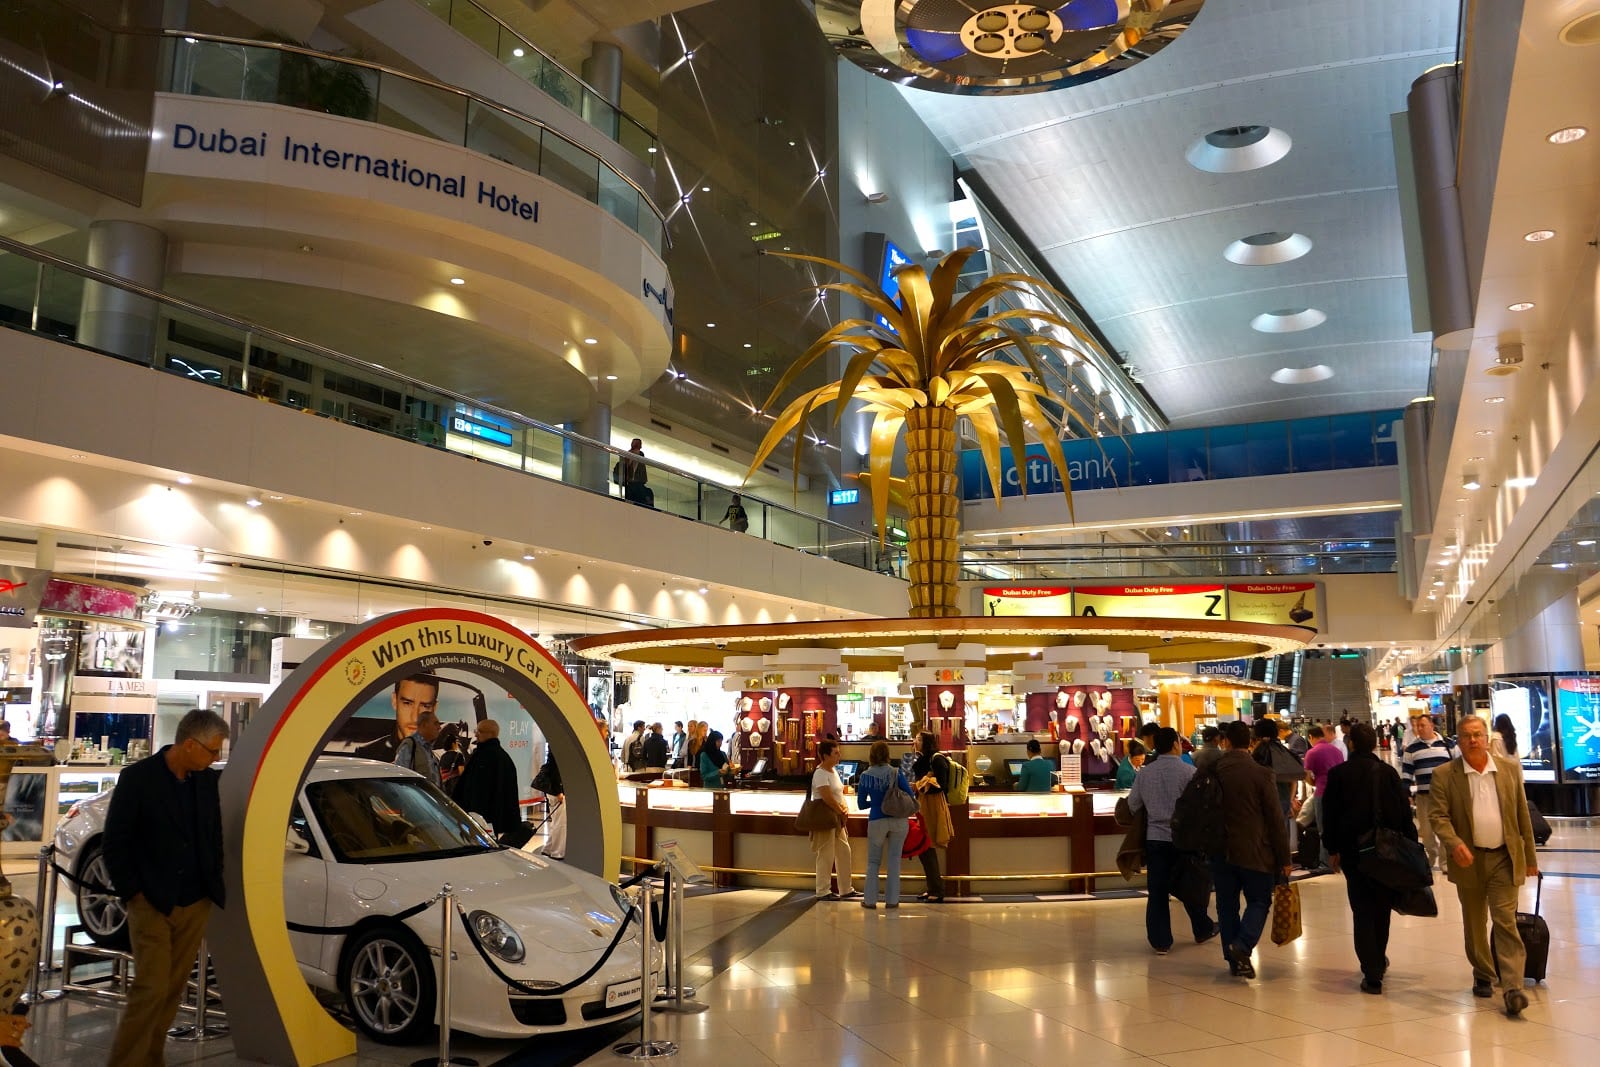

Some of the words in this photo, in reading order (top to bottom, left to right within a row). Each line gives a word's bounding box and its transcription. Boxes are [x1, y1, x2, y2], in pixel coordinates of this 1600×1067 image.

[173, 124, 267, 157] Dubai
[284, 136, 466, 198] International
[477, 181, 539, 223] Hotel
[842, 490, 858, 503] 117
[1022, 589, 1036, 597] Duty
[1204, 594, 1222, 617] Z
[372, 635, 415, 669] Win
[418, 626, 452, 649] this
[456, 624, 514, 663] Luxury
[517, 648, 544, 679] Car
[420, 656, 439, 668] 1,000
[439, 655, 460, 664] tickets
[460, 656, 466, 664] at
[467, 656, 479, 666] Dhs
[479, 658, 491, 668] 500
[491, 662, 505, 674] each
[510, 720, 529, 736] PLAY
